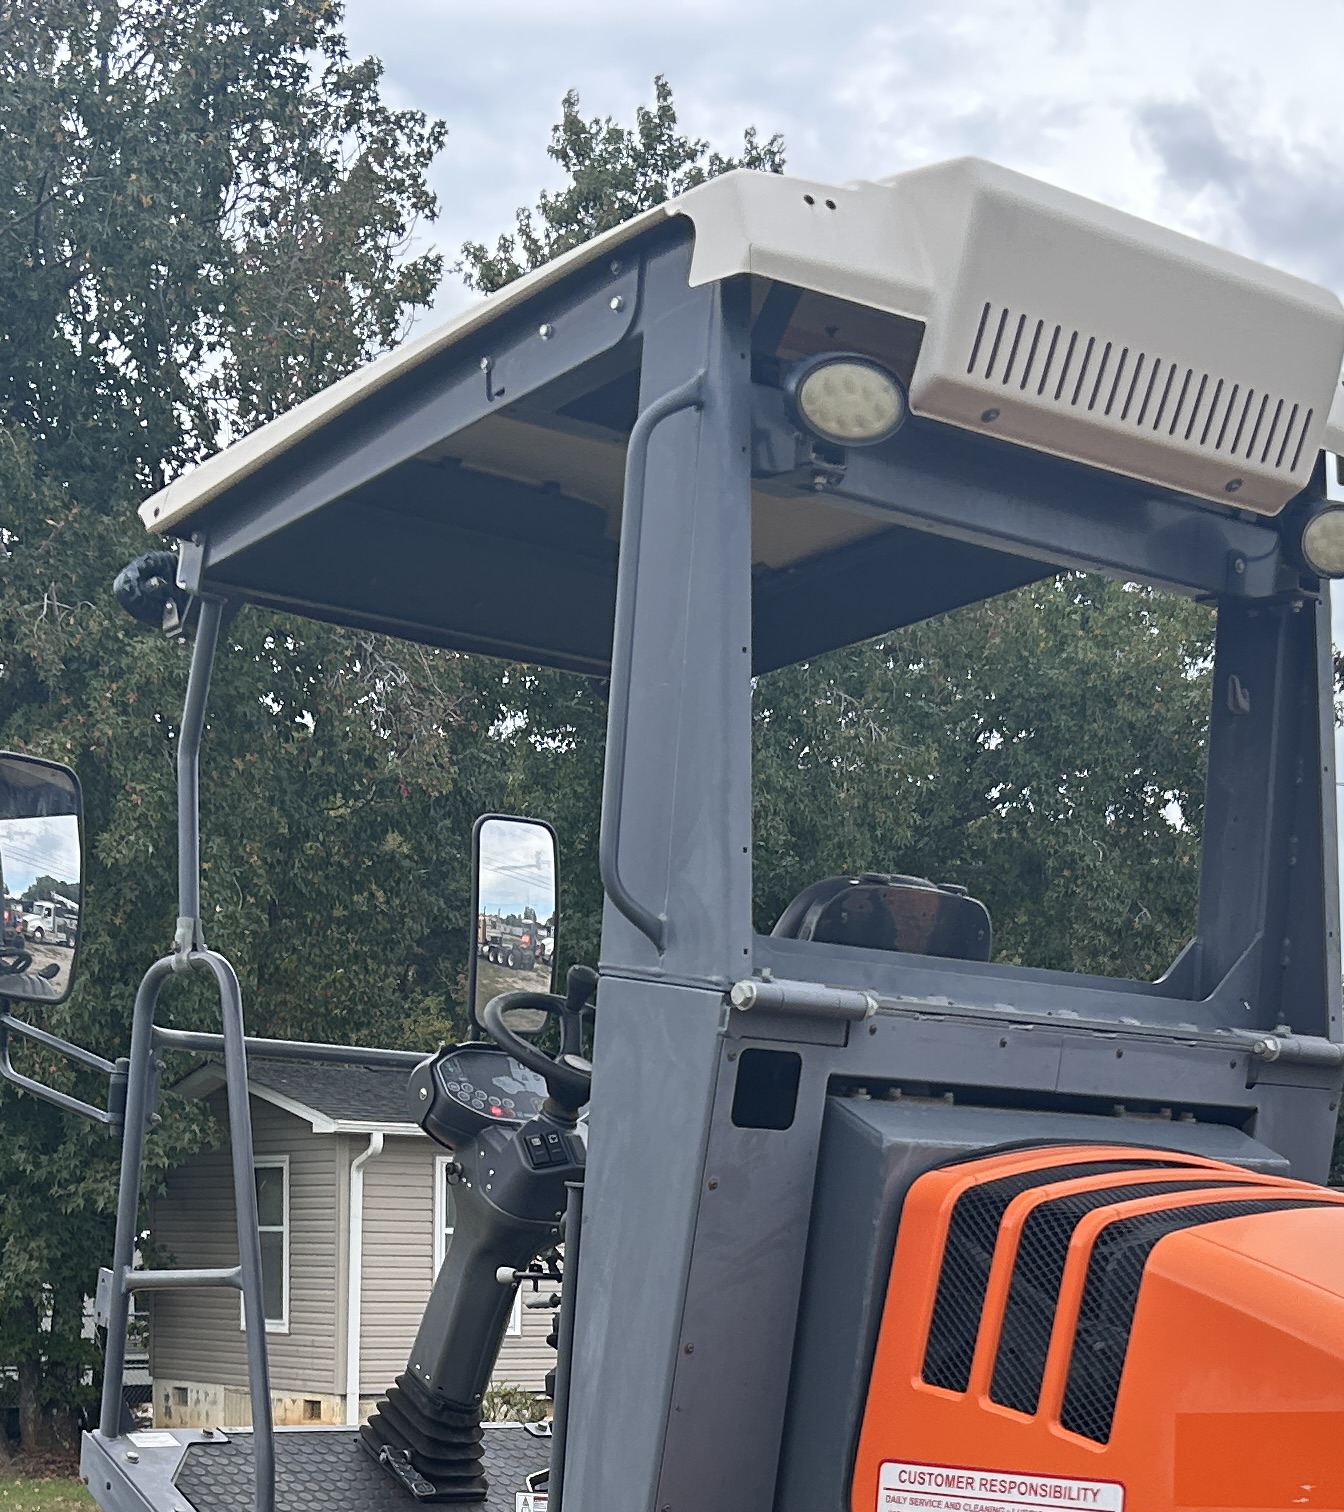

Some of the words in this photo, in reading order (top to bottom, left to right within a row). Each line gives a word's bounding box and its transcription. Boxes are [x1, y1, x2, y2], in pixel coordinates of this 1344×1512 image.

[898, 1469, 975, 1491] CUSTOMER
[978, 1477, 1100, 1503] RESPONSIBILITY
[885, 1494, 907, 1505] DAILY
[908, 1497, 942, 1509] SERVICE
[943, 1500, 961, 1511] AND
